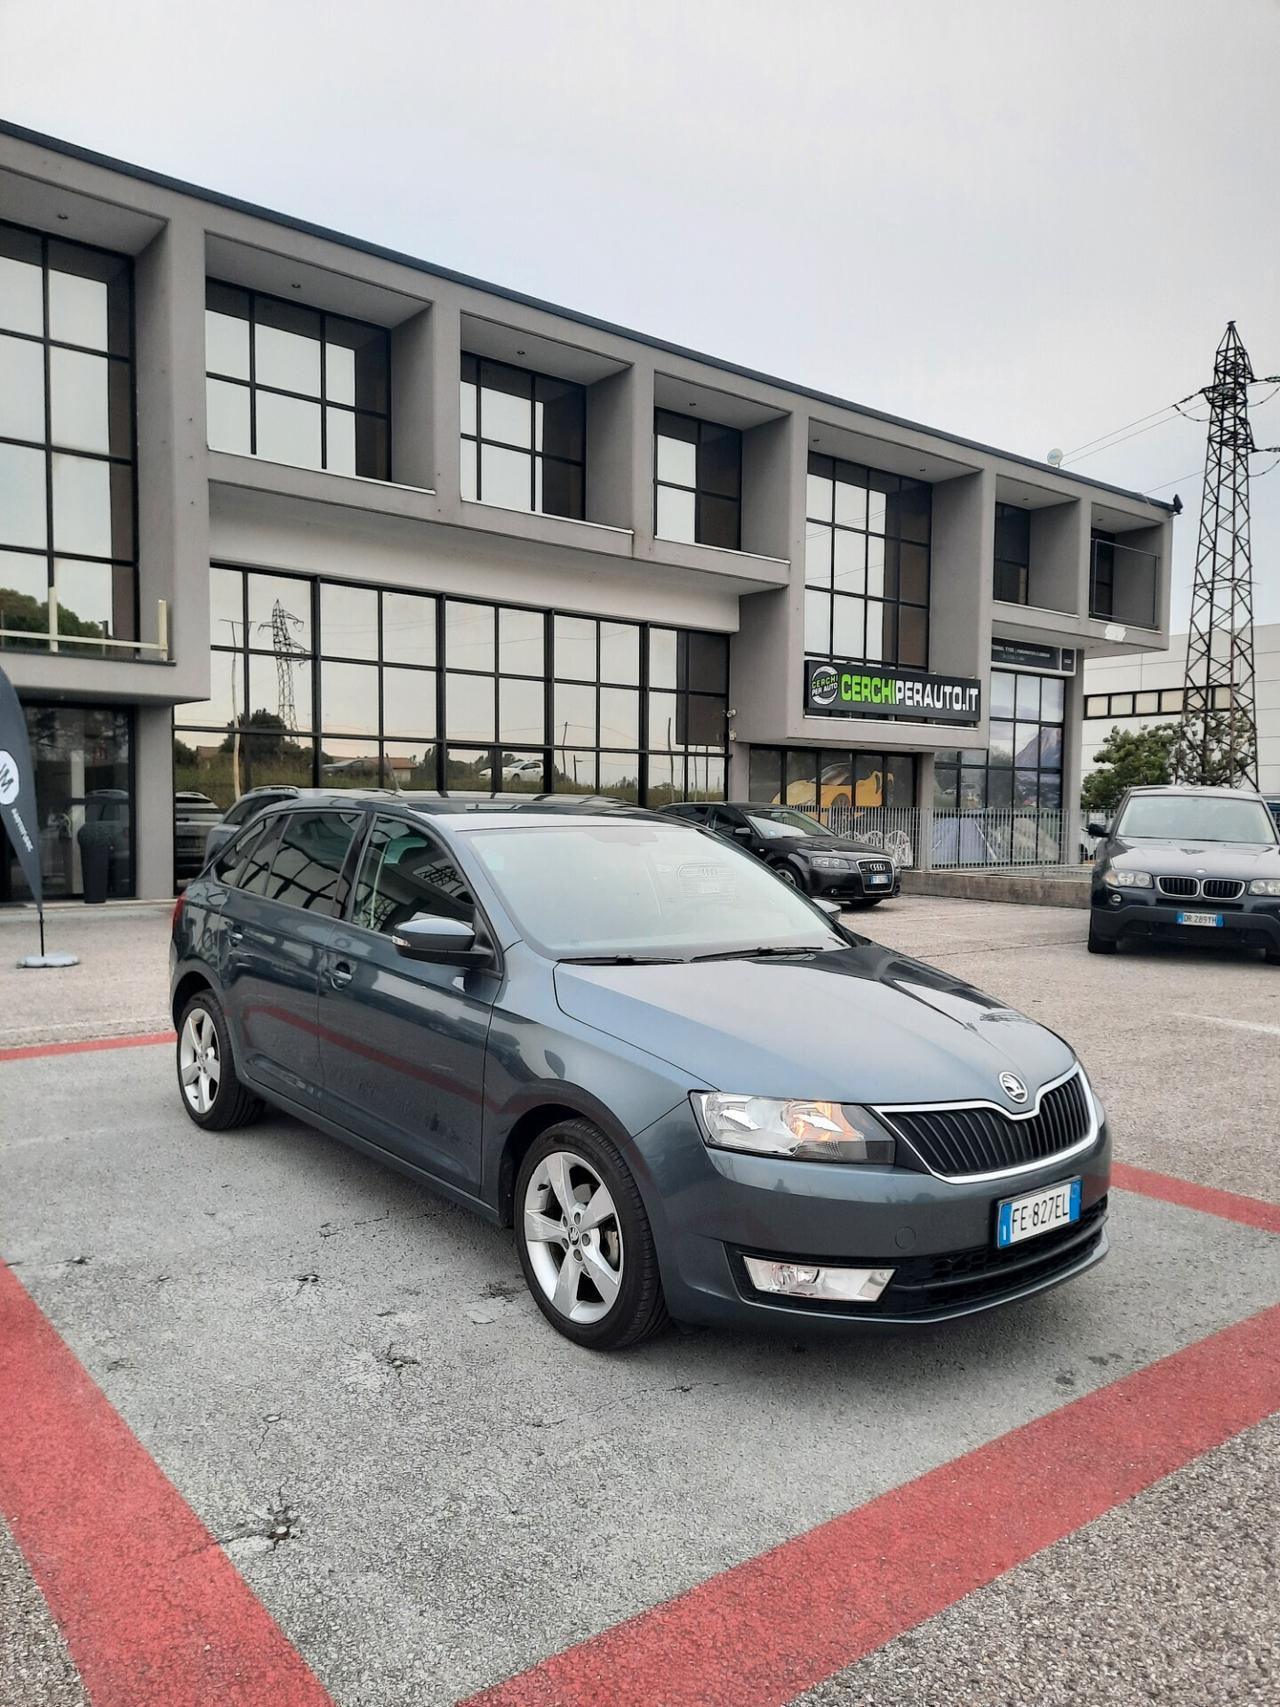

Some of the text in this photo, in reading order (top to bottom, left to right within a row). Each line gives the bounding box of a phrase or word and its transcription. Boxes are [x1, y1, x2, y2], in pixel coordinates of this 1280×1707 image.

[811, 674, 838, 689] CERCHI
[811, 682, 838, 696] PER AUTO
[841, 674, 979, 712] CERCHIPERAUTO.IT
[1012, 1193, 1069, 1234] FE 827EL
